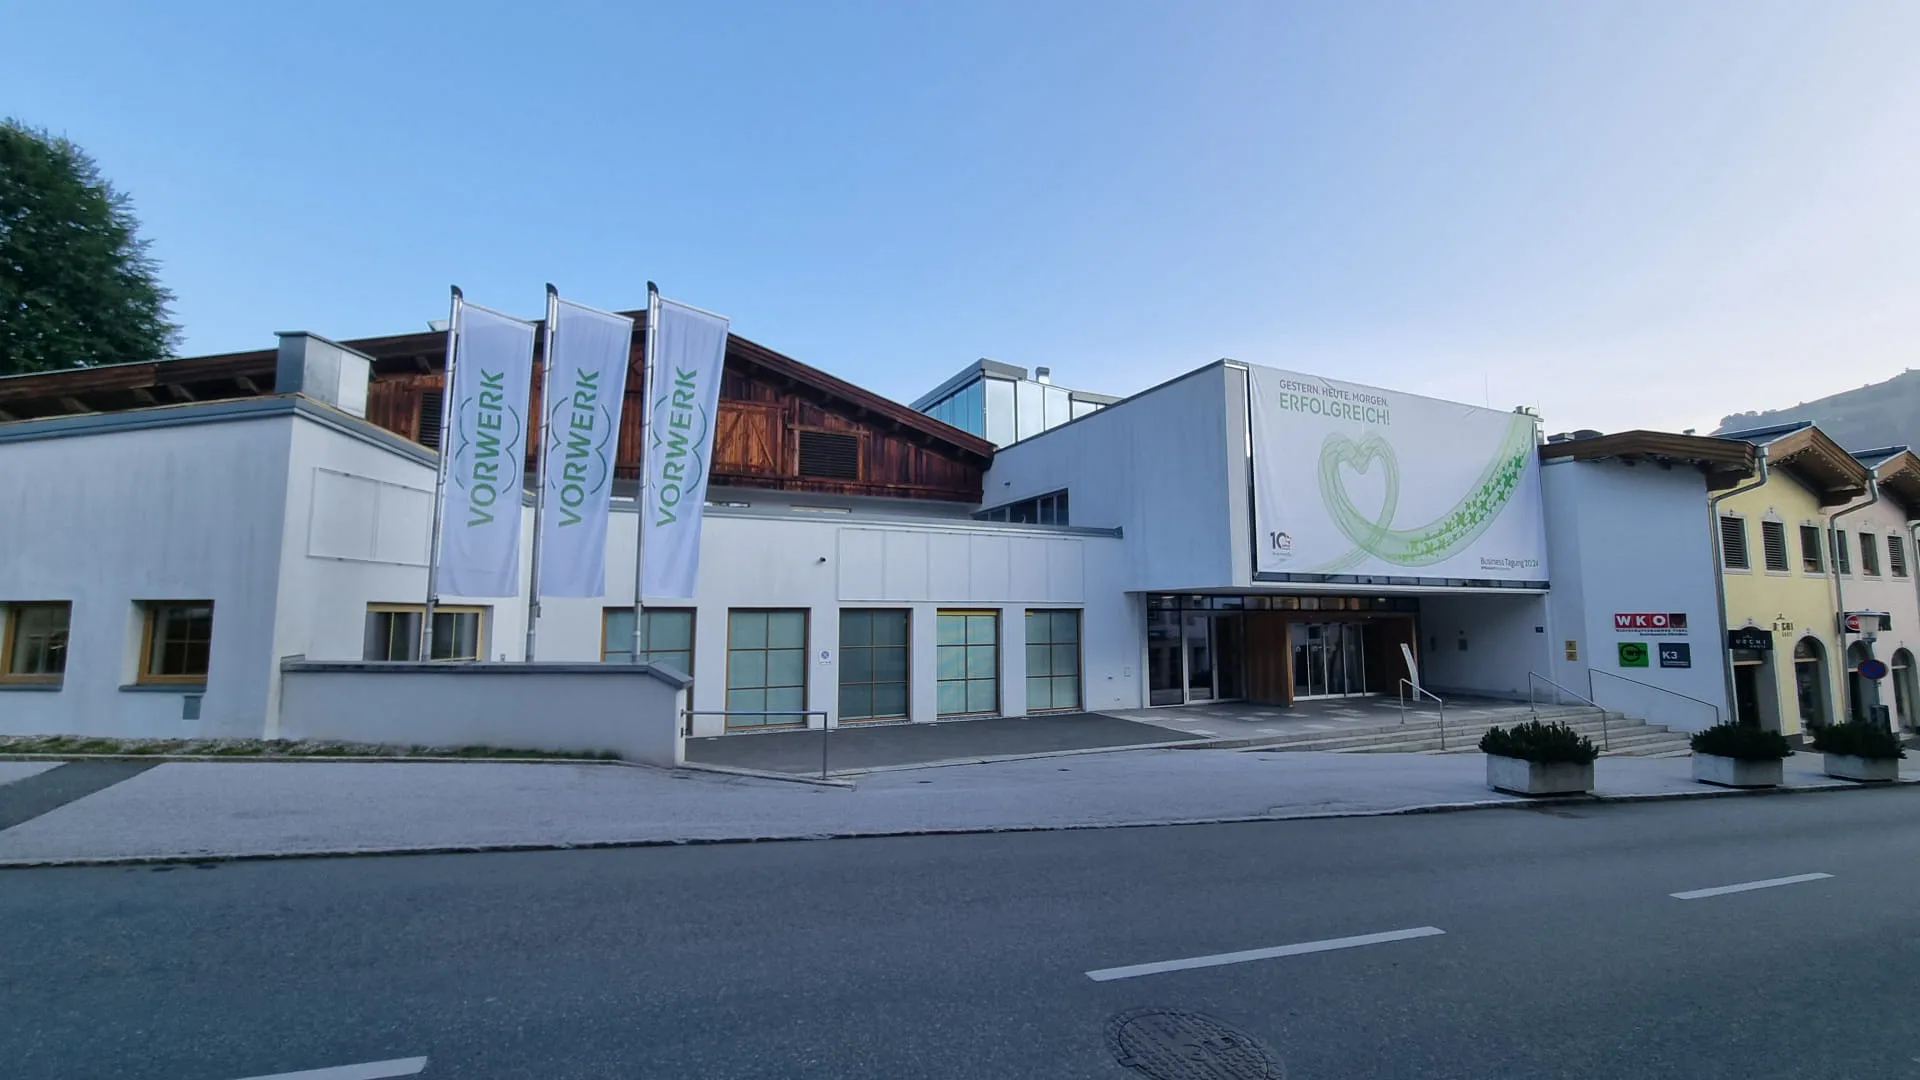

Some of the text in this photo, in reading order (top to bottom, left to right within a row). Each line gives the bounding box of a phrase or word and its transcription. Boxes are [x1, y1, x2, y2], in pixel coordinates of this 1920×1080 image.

[1279, 379, 1389, 407] GESTERN. HEUTE. MORGEN.
[1279, 392, 1390, 426] ERFOLGREICH!
[467, 367, 504, 528] VORWERK
[558, 367, 600, 528] VORWERK
[655, 366, 697, 528] VORWERK
[1616, 615, 1666, 626] WKO
[1662, 651, 1678, 660] K3
